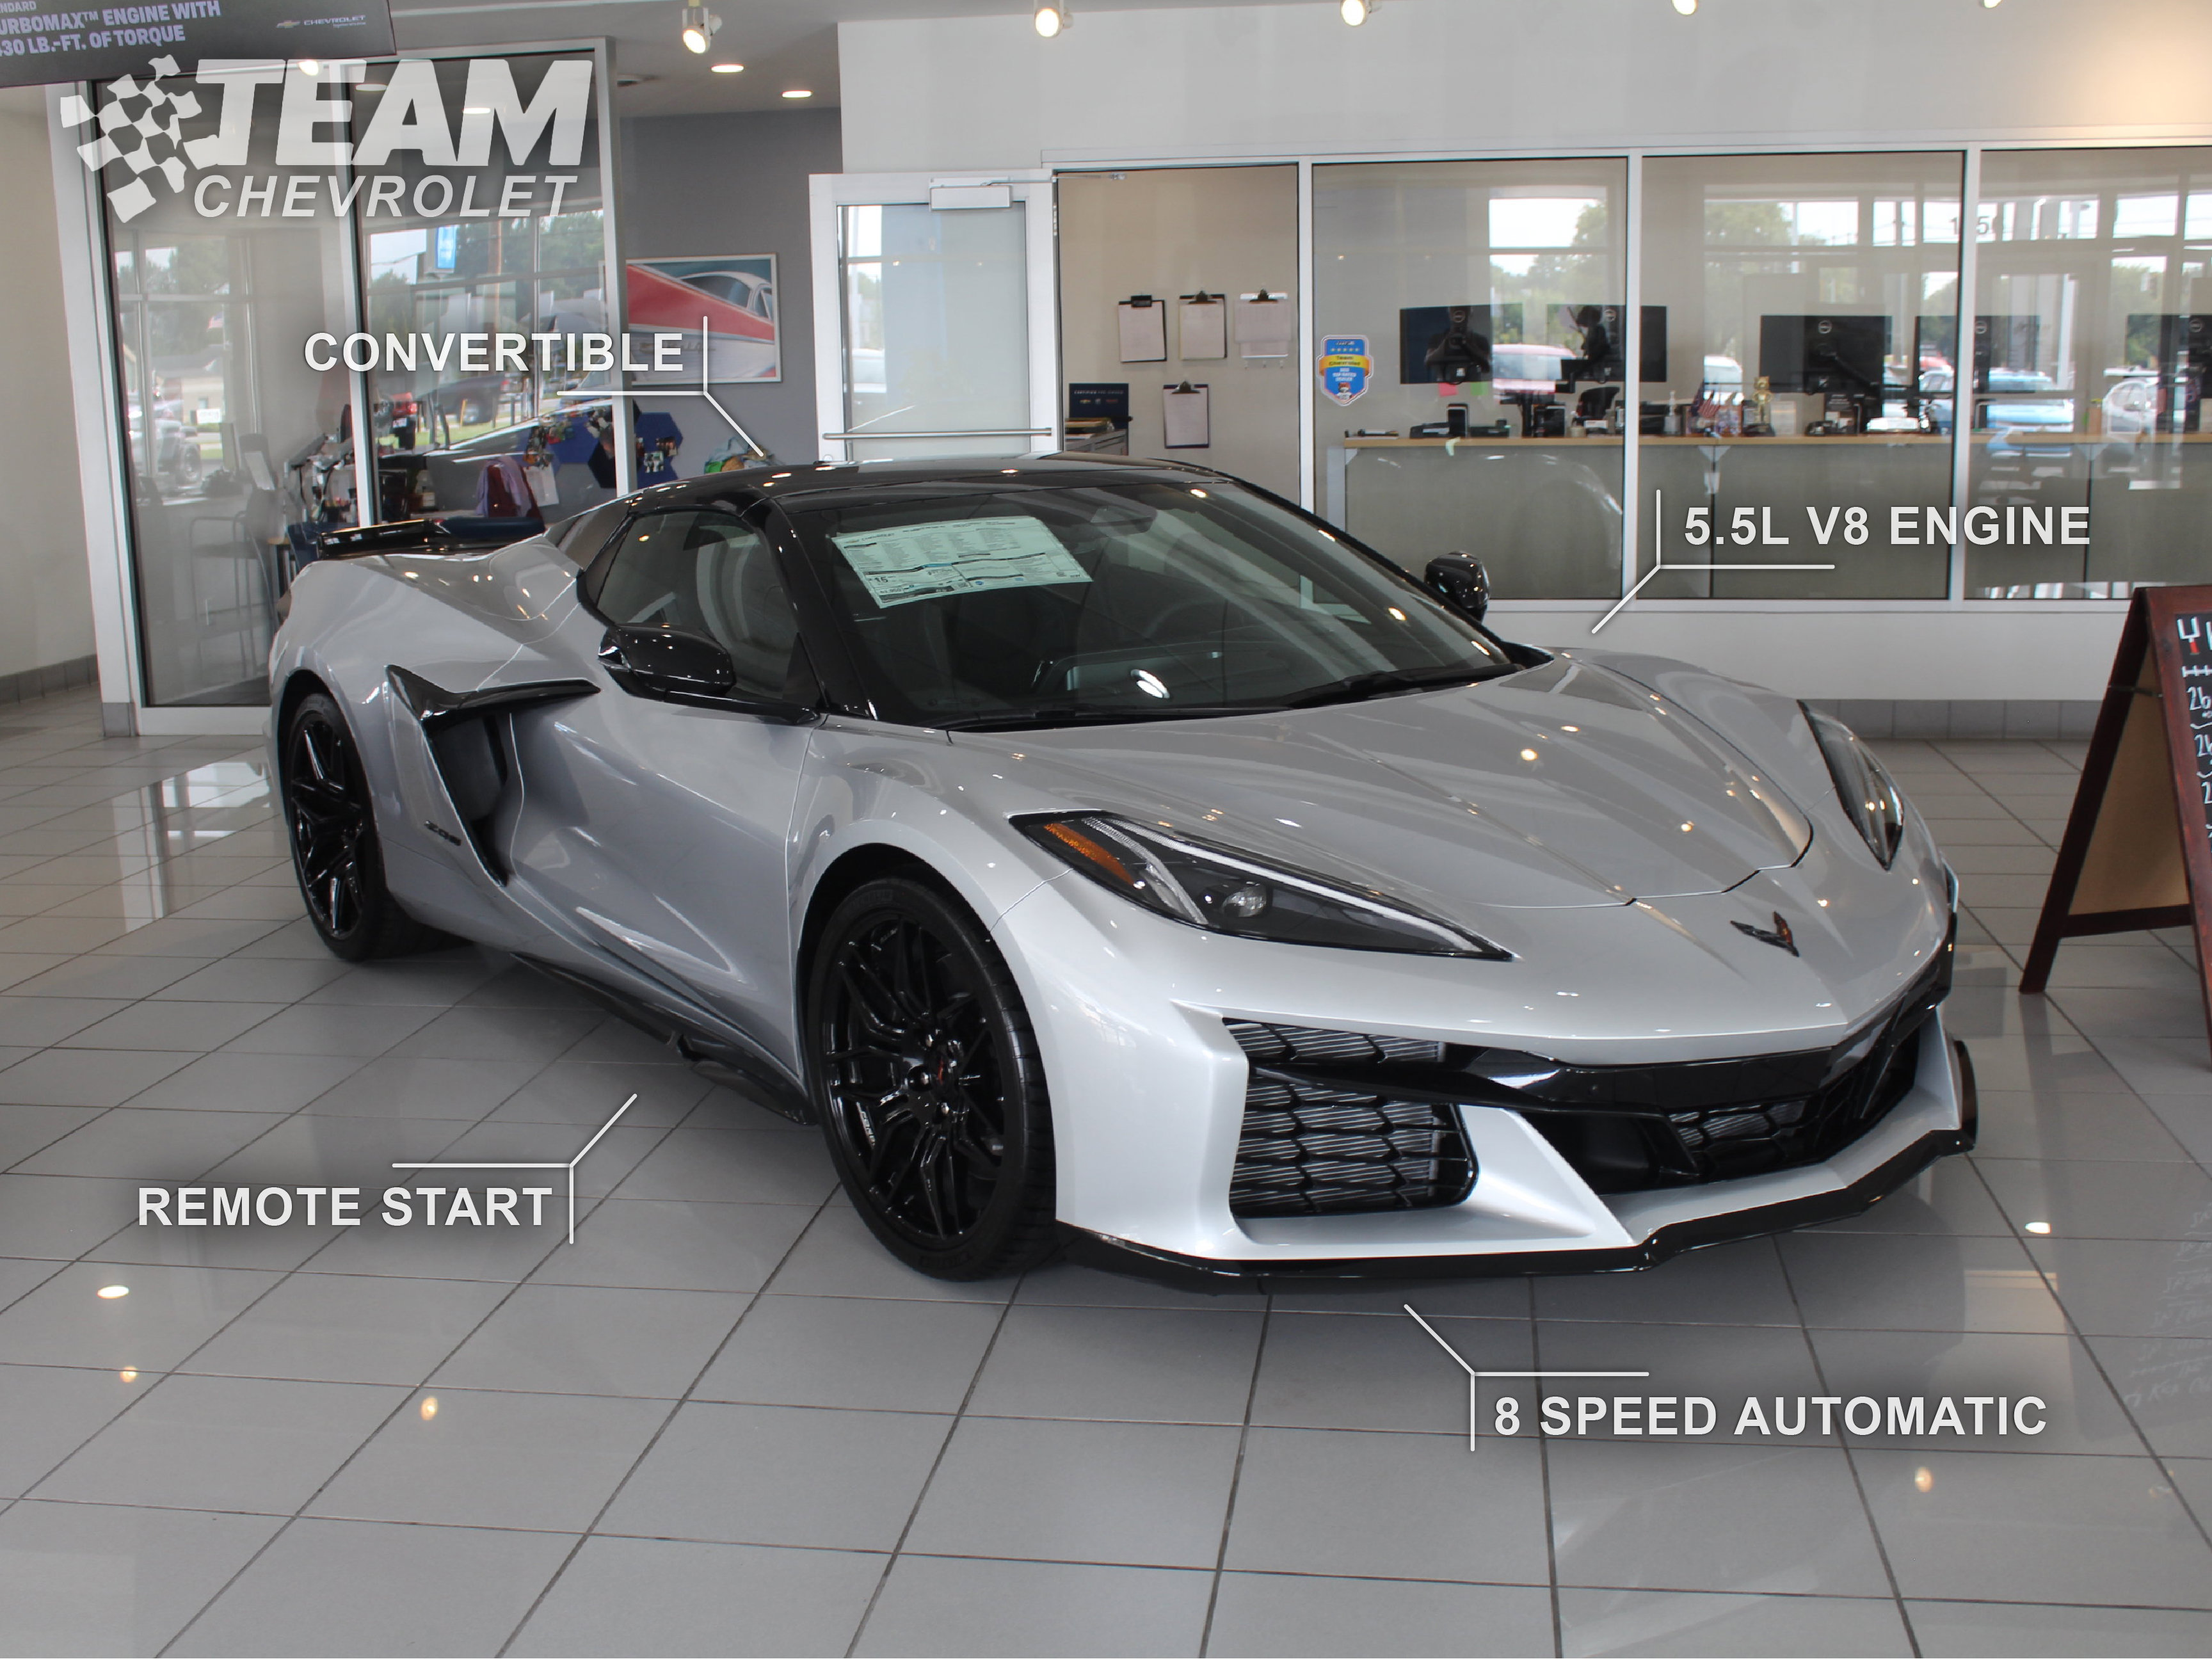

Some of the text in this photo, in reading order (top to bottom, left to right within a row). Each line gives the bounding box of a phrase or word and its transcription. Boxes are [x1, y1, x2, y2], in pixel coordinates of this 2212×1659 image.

[0, 1, 37, 13] NDARD
[102, 5, 170, 26] ENGINE
[172, 0, 221, 20] WITH
[304, 15, 366, 26] CHEVROLET
[28, 34, 87, 54] LB.-FT.
[90, 30, 113, 49] OF
[113, 24, 186, 47] TORQUE
